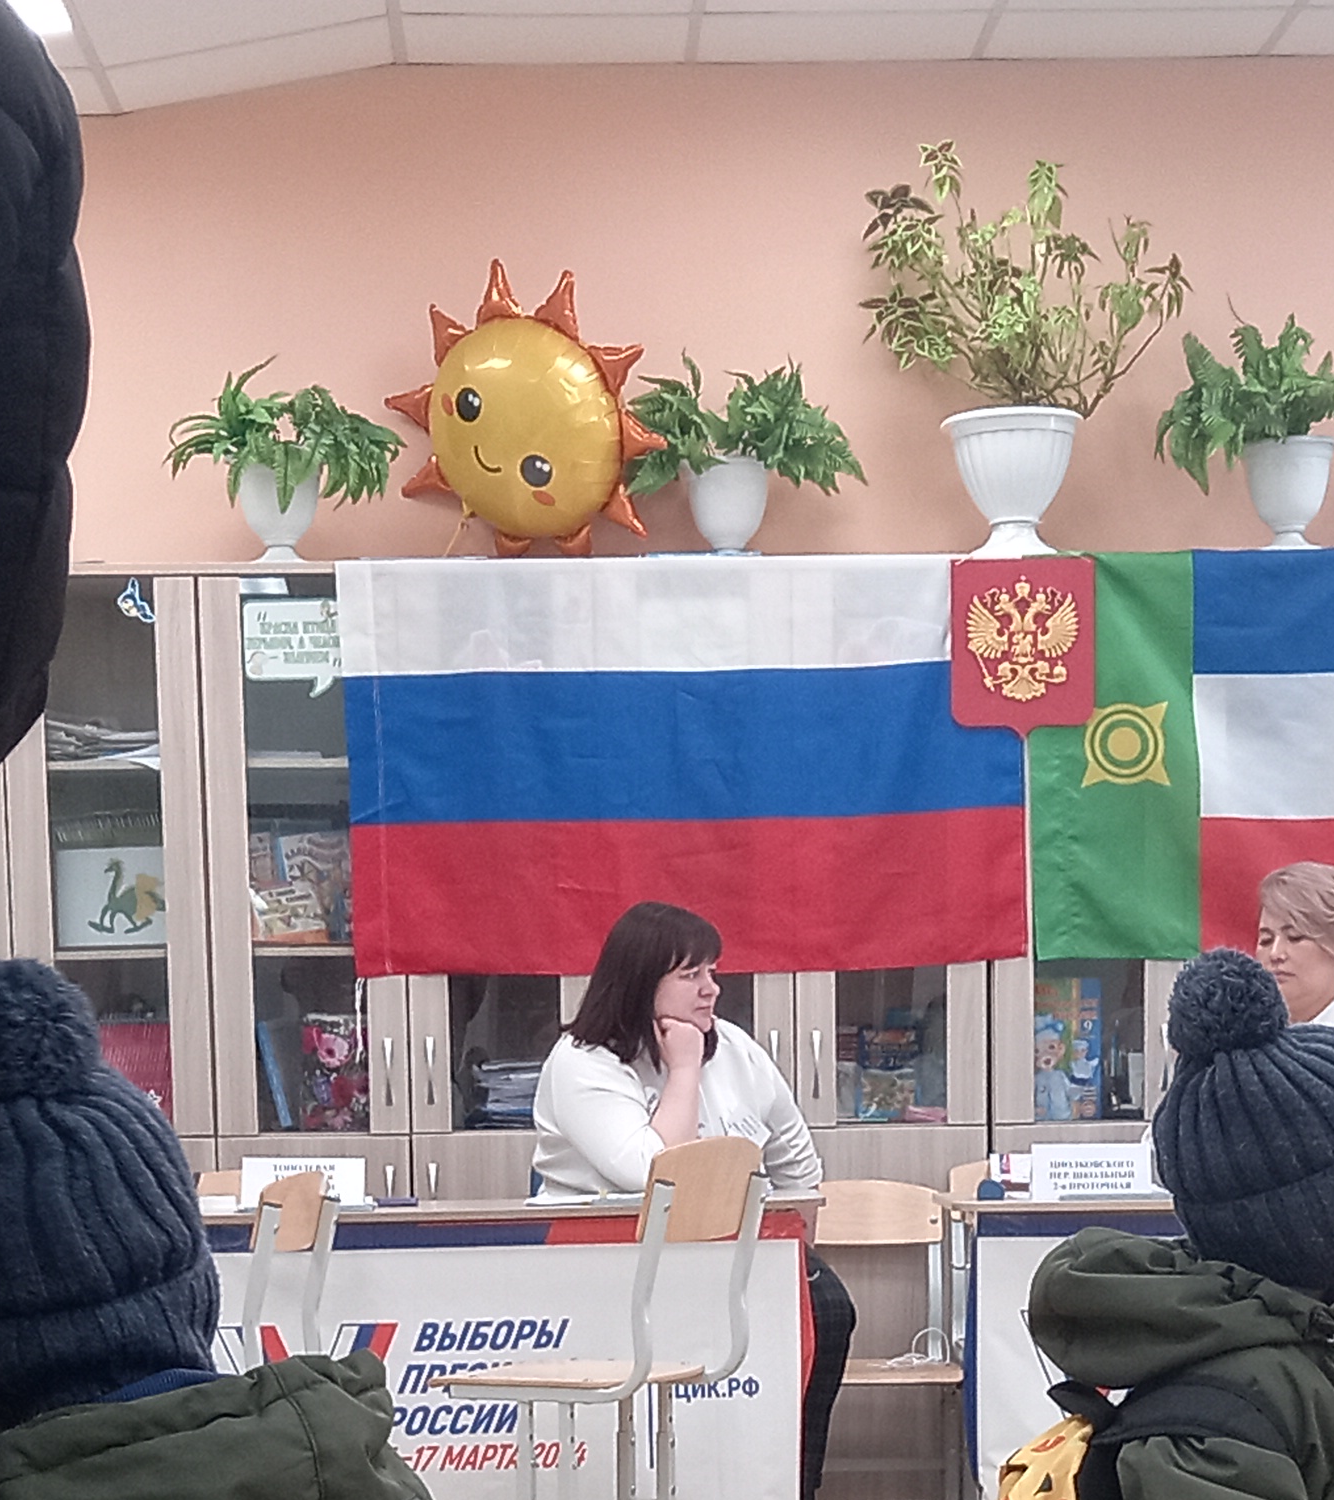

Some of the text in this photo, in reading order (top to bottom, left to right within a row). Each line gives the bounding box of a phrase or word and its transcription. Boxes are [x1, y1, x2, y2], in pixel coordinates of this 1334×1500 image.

[413, 1318, 570, 1352] ВЫБОРЫ
[675, 1376, 760, 1403] ЦИК.РФ
[393, 1402, 518, 1437] РОССИИ
[439, 1443, 518, 1471] МАРТА
[534, 1441, 588, 1469] 204
